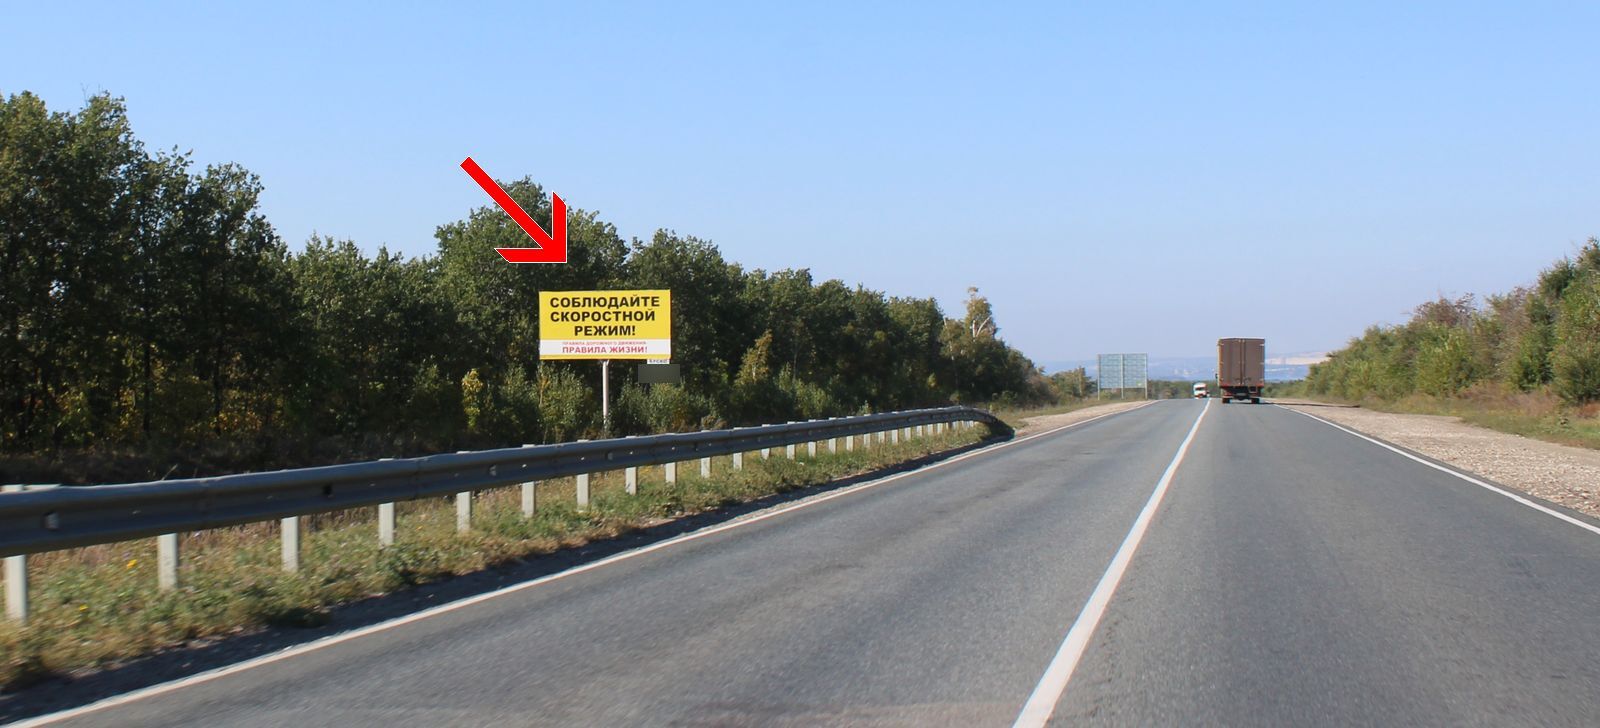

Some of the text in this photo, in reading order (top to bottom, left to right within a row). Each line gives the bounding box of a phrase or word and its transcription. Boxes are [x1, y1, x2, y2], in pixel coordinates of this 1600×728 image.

[550, 295, 660, 309] СОБЛЮДАЙТЕ
[550, 309, 655, 322] СКОРОСТНОЙ
[574, 325, 636, 336] РЕЖИМ!
